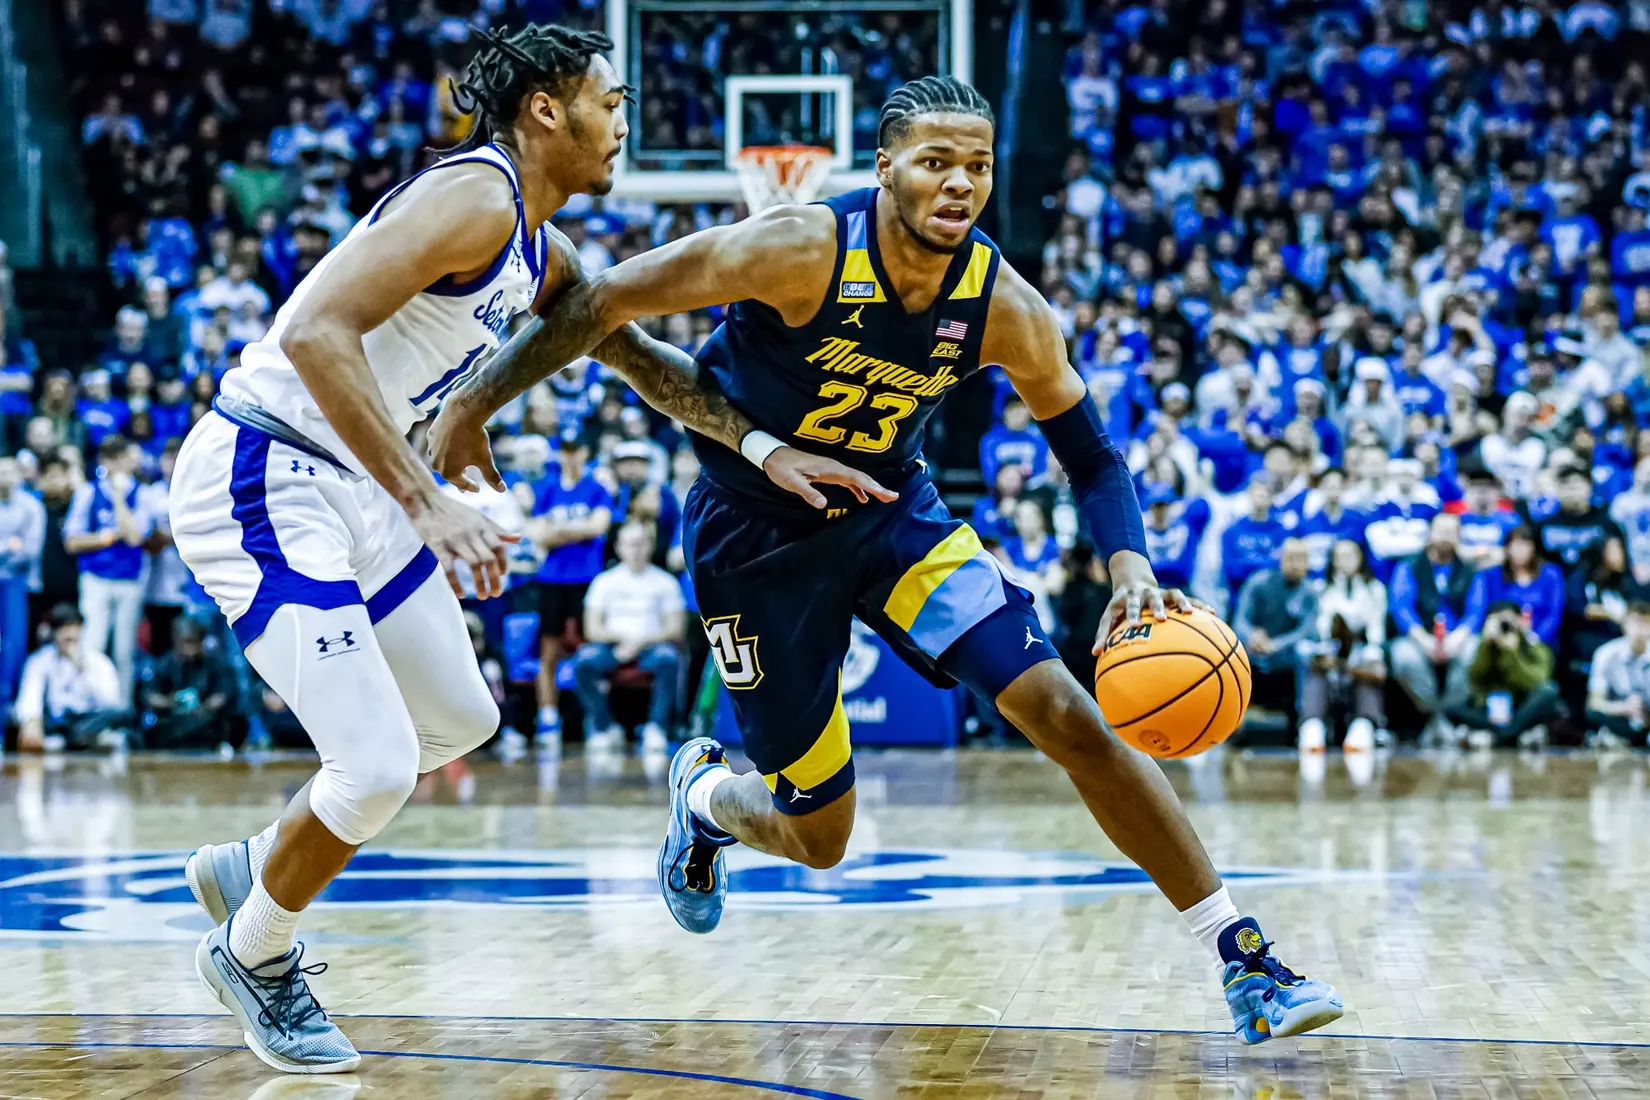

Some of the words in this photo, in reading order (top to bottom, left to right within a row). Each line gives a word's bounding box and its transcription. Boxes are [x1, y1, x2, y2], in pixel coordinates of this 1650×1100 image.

[932, 347, 963, 357] EAST
[937, 341, 959, 350] BIG
[804, 336, 959, 397] Marquette
[793, 380, 918, 453] 23
